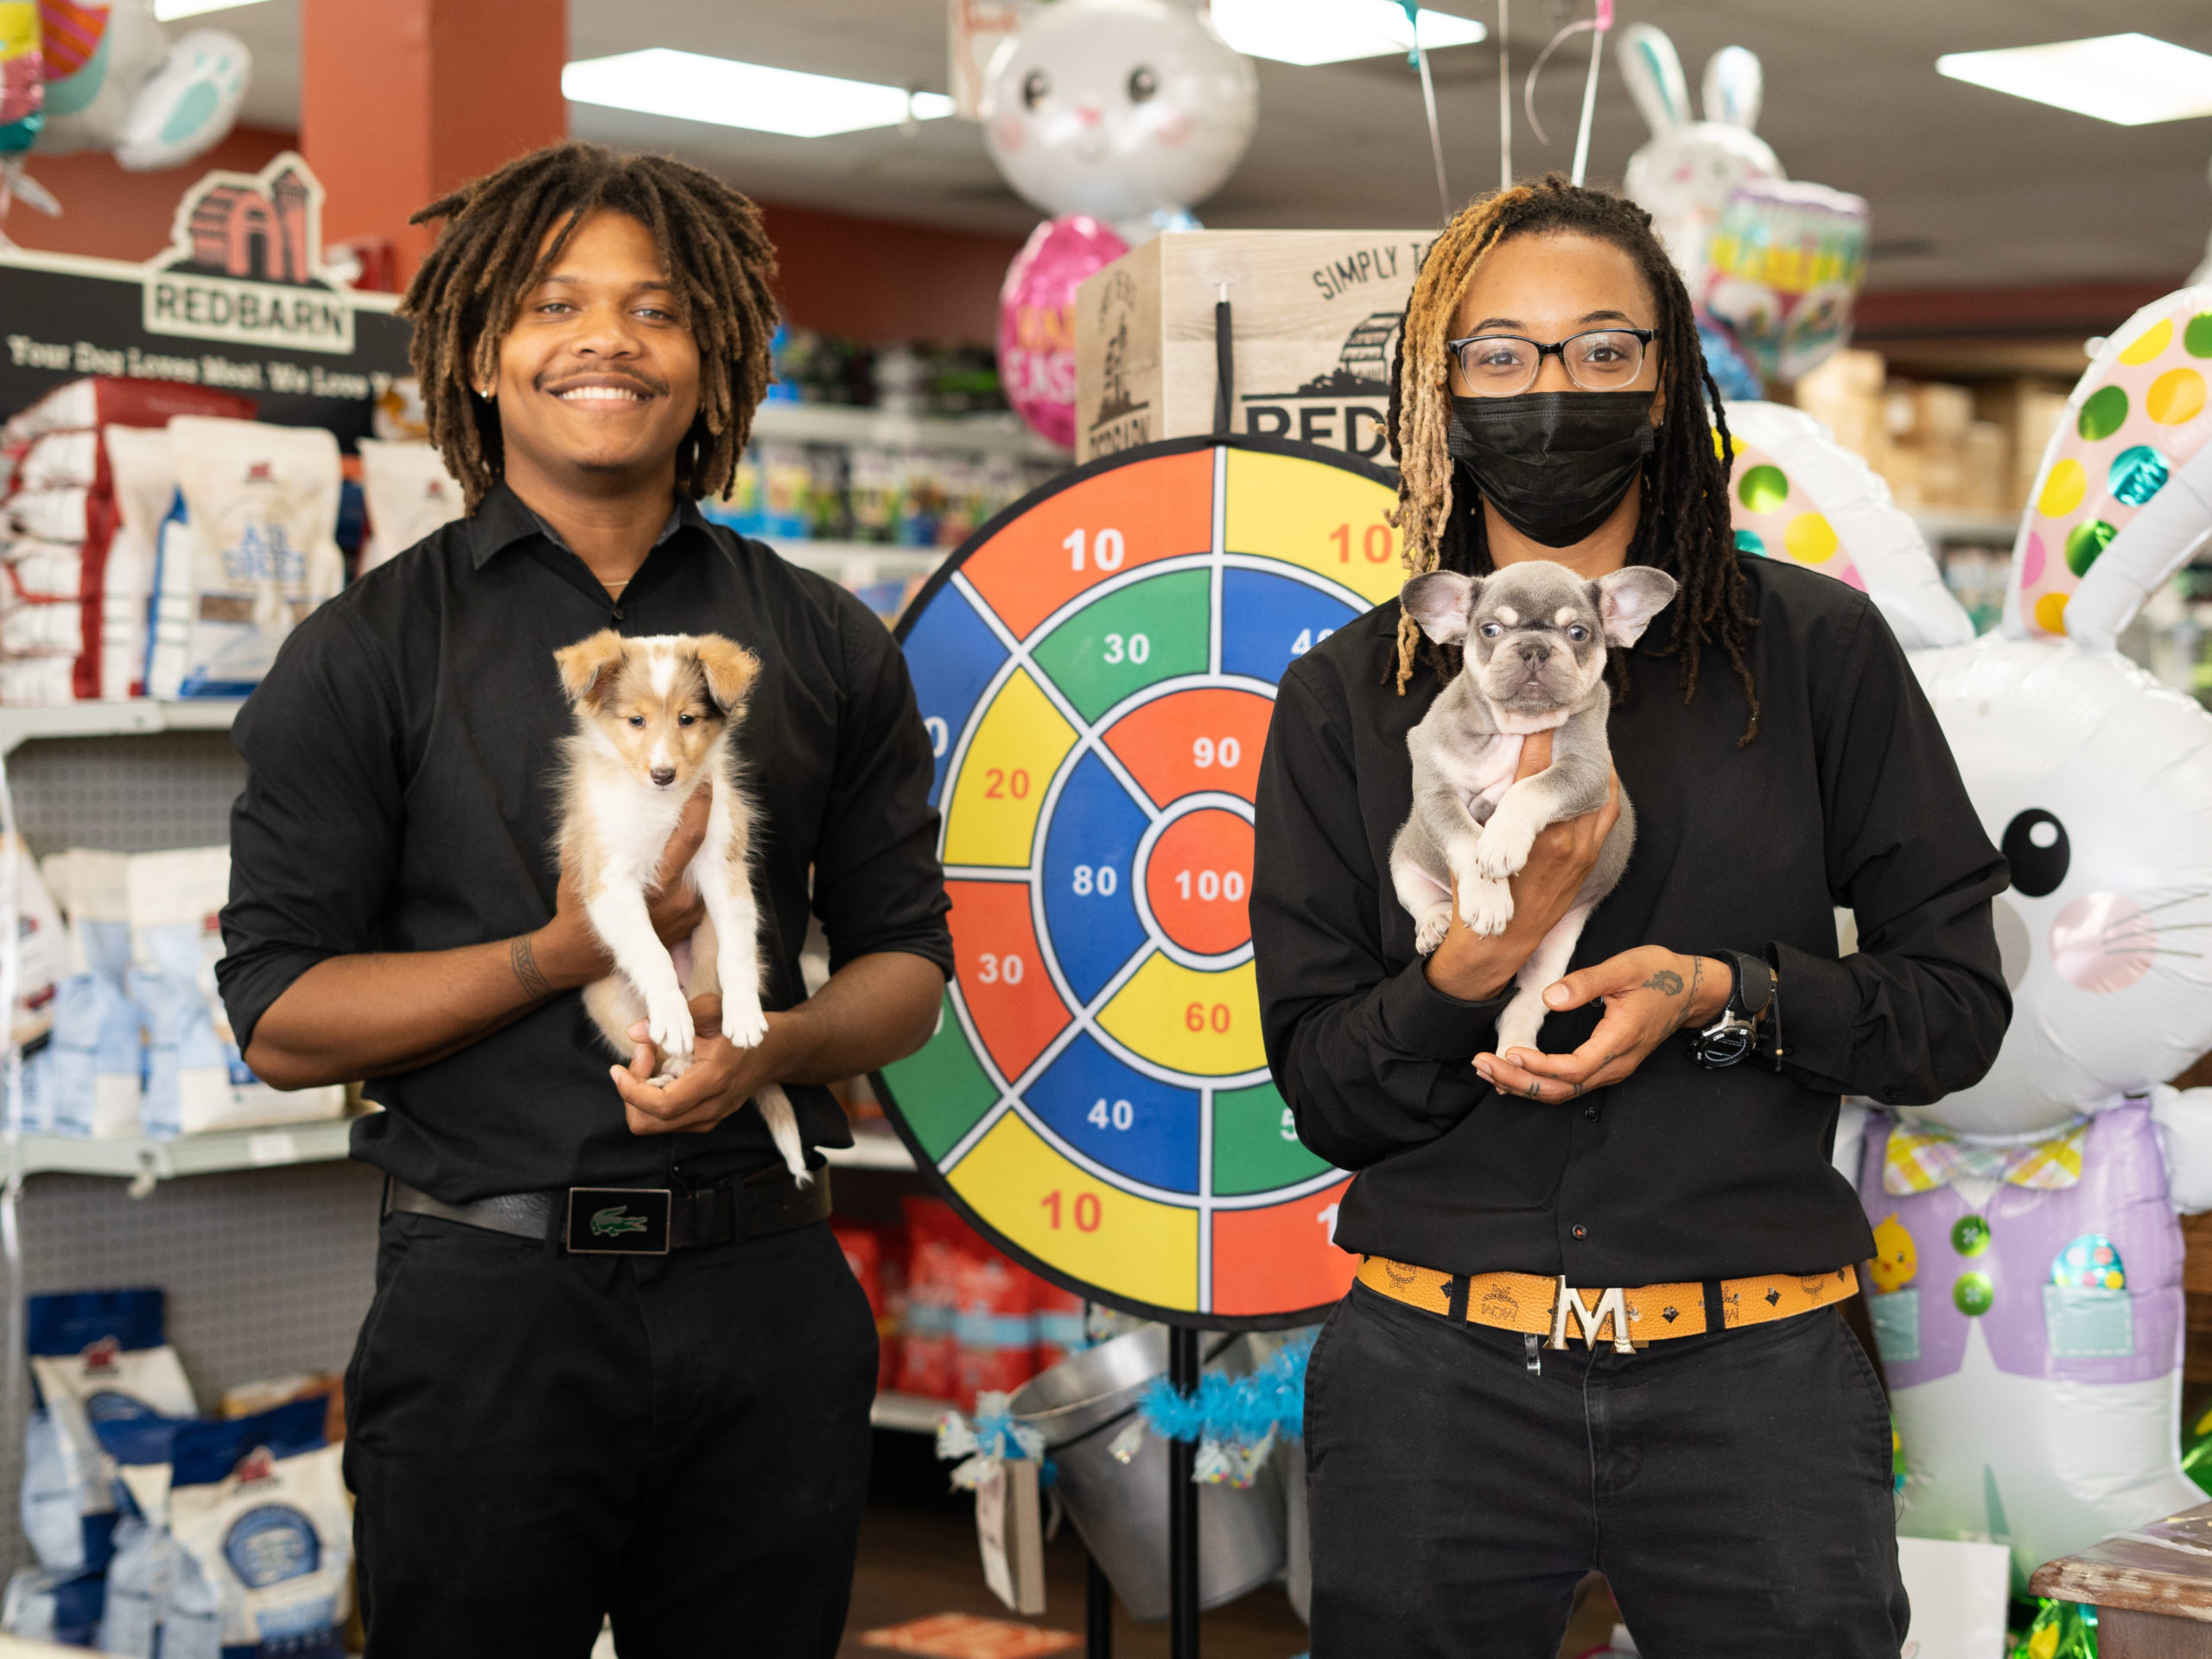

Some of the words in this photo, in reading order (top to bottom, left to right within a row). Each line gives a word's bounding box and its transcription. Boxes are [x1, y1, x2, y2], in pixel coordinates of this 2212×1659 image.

[1313, 245, 1397, 300] SIMPLY
[1411, 243, 1430, 275] T
[156, 283, 343, 340] REDBARN
[7, 334, 71, 371] Your
[74, 340, 124, 378] Dog
[127, 346, 199, 384] Loves
[267, 360, 309, 395] We
[311, 365, 369, 400] Love
[1246, 406, 1389, 458] RED
[1063, 528, 1125, 570] 10
[1330, 523, 1393, 565] 10
[1103, 632, 1150, 664] 30
[924, 716, 949, 758] 0
[1192, 736, 1241, 768] 90
[984, 767, 1031, 800] 20
[1072, 864, 1117, 896] 80
[1175, 869, 1245, 902] 100
[978, 952, 1024, 985] 30
[1185, 1001, 1231, 1034] 60
[1087, 1098, 1134, 1131] 40
[1280, 1108, 1299, 1141] 5
[1040, 1189, 1103, 1233] 10
[1317, 1203, 1339, 1246] 1
[1542, 1274, 1637, 1355] M
